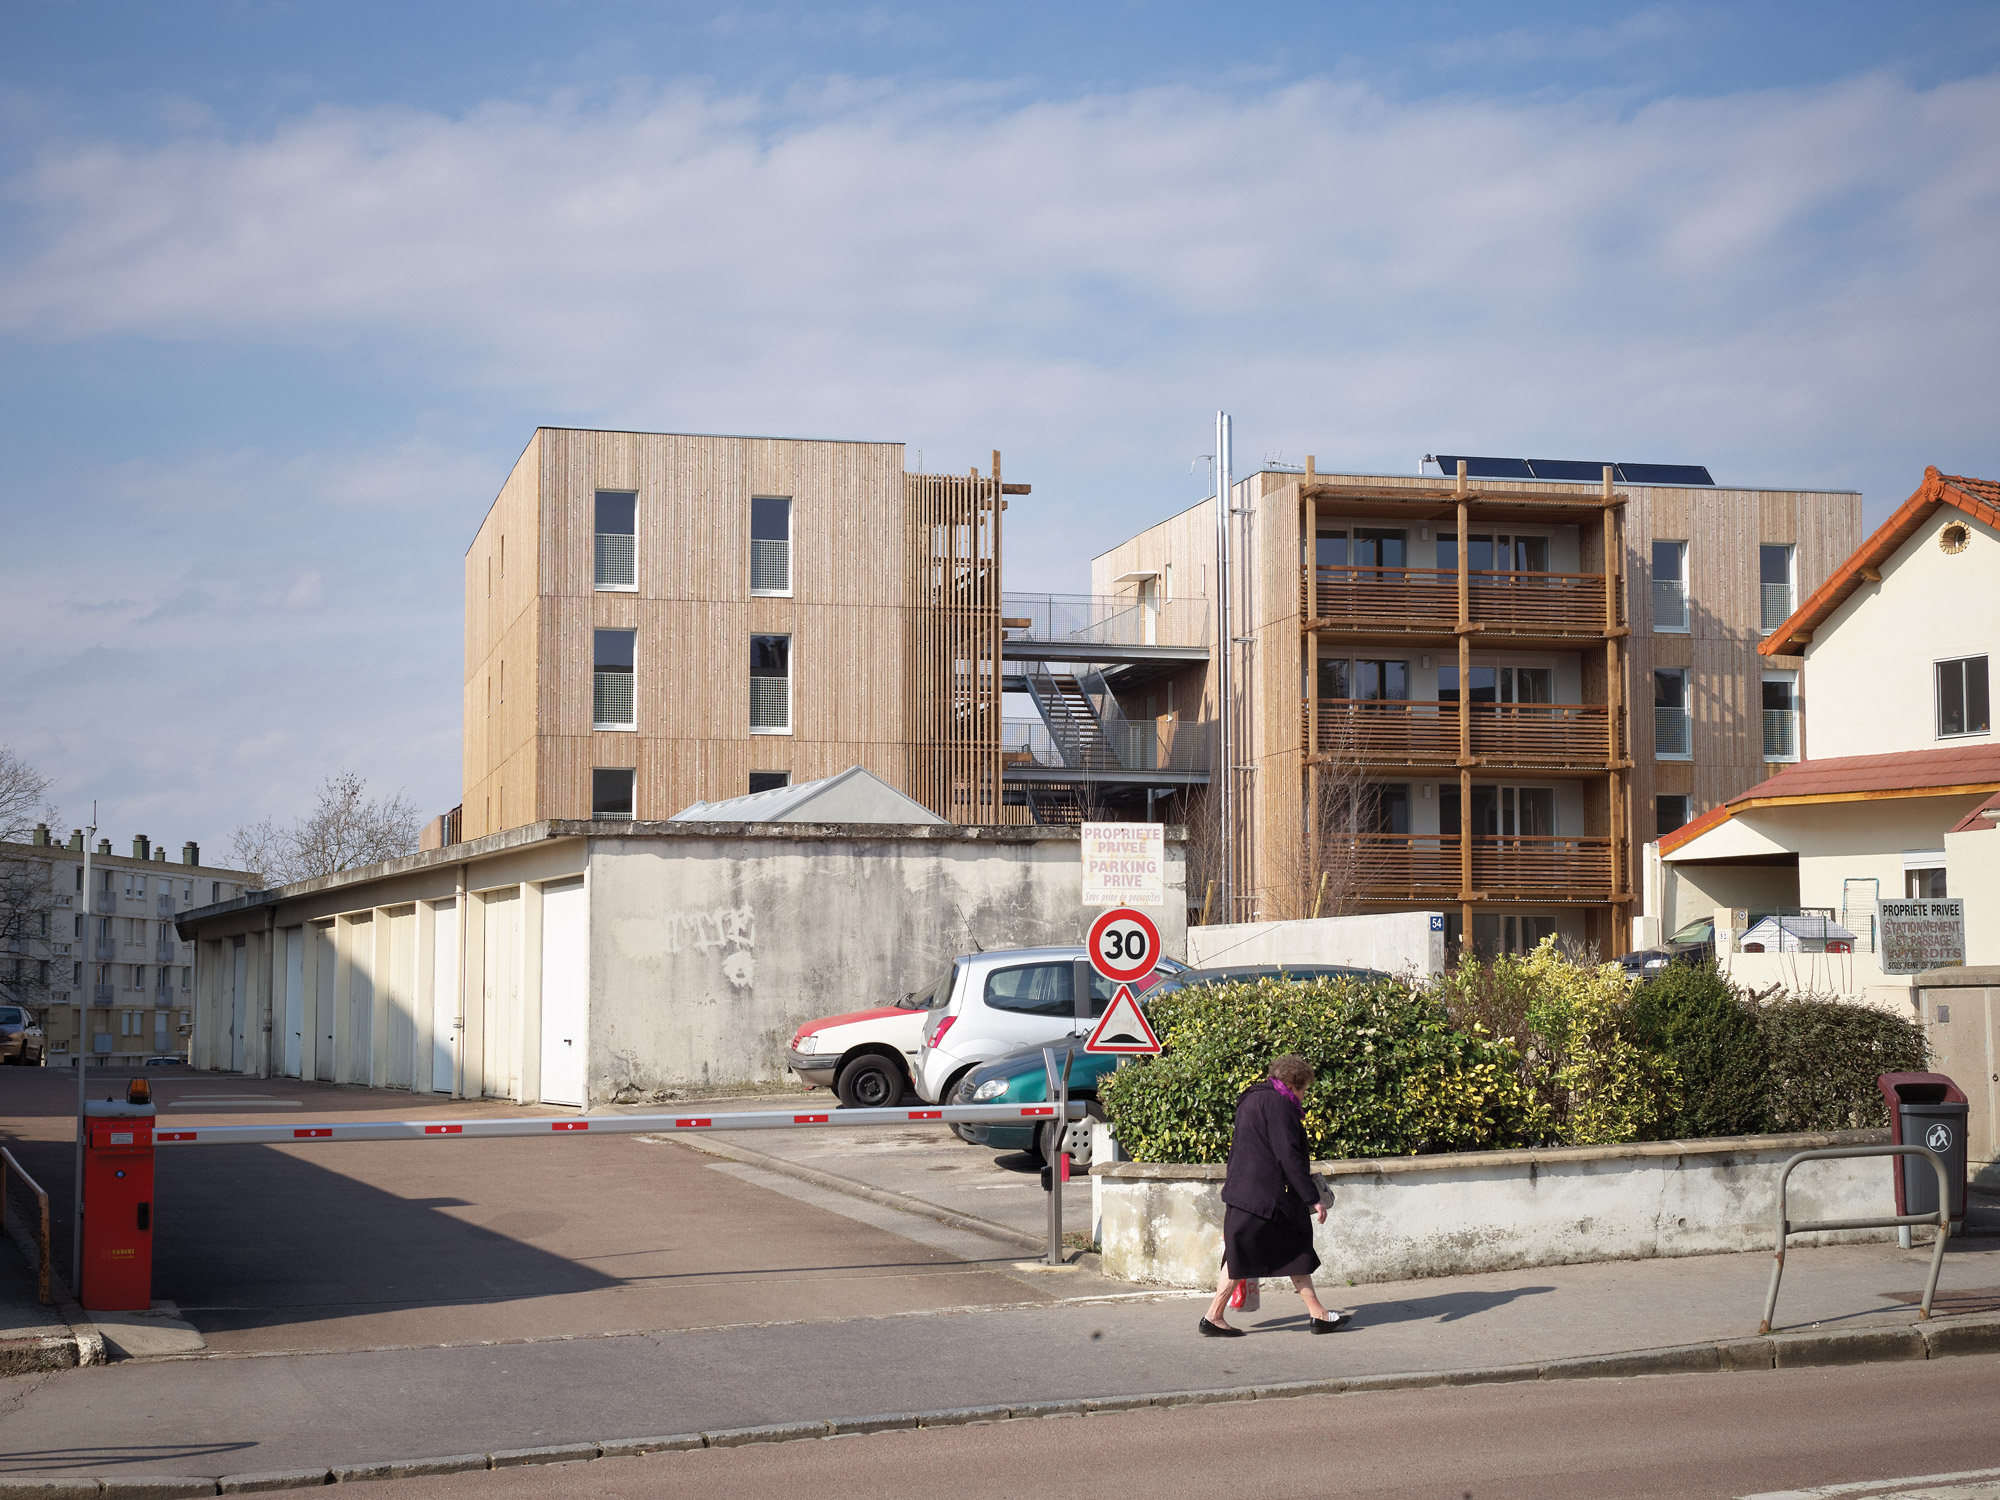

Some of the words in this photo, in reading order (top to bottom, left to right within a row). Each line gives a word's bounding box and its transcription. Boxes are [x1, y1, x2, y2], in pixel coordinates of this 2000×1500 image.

[1084, 828, 1160, 840] PROPRIETE
[1098, 842, 1146, 853] PRIVEE
[1090, 861, 1156, 873] PARKING
[1104, 875, 1142, 887] PRIVE
[1085, 892, 1099, 901] Sous
[1101, 891, 1118, 902] peine
[1120, 893, 1127, 901] de
[1883, 904, 1927, 916] PROPRIETE
[1931, 904, 1959, 916] PRIVEE
[1432, 918, 1441, 928] 54
[1885, 921, 1960, 934] STATIONNEMENT
[1105, 930, 1145, 959] 30
[1911, 935, 1951, 946] PASSAGE
[1888, 961, 1902, 970] SOUS
